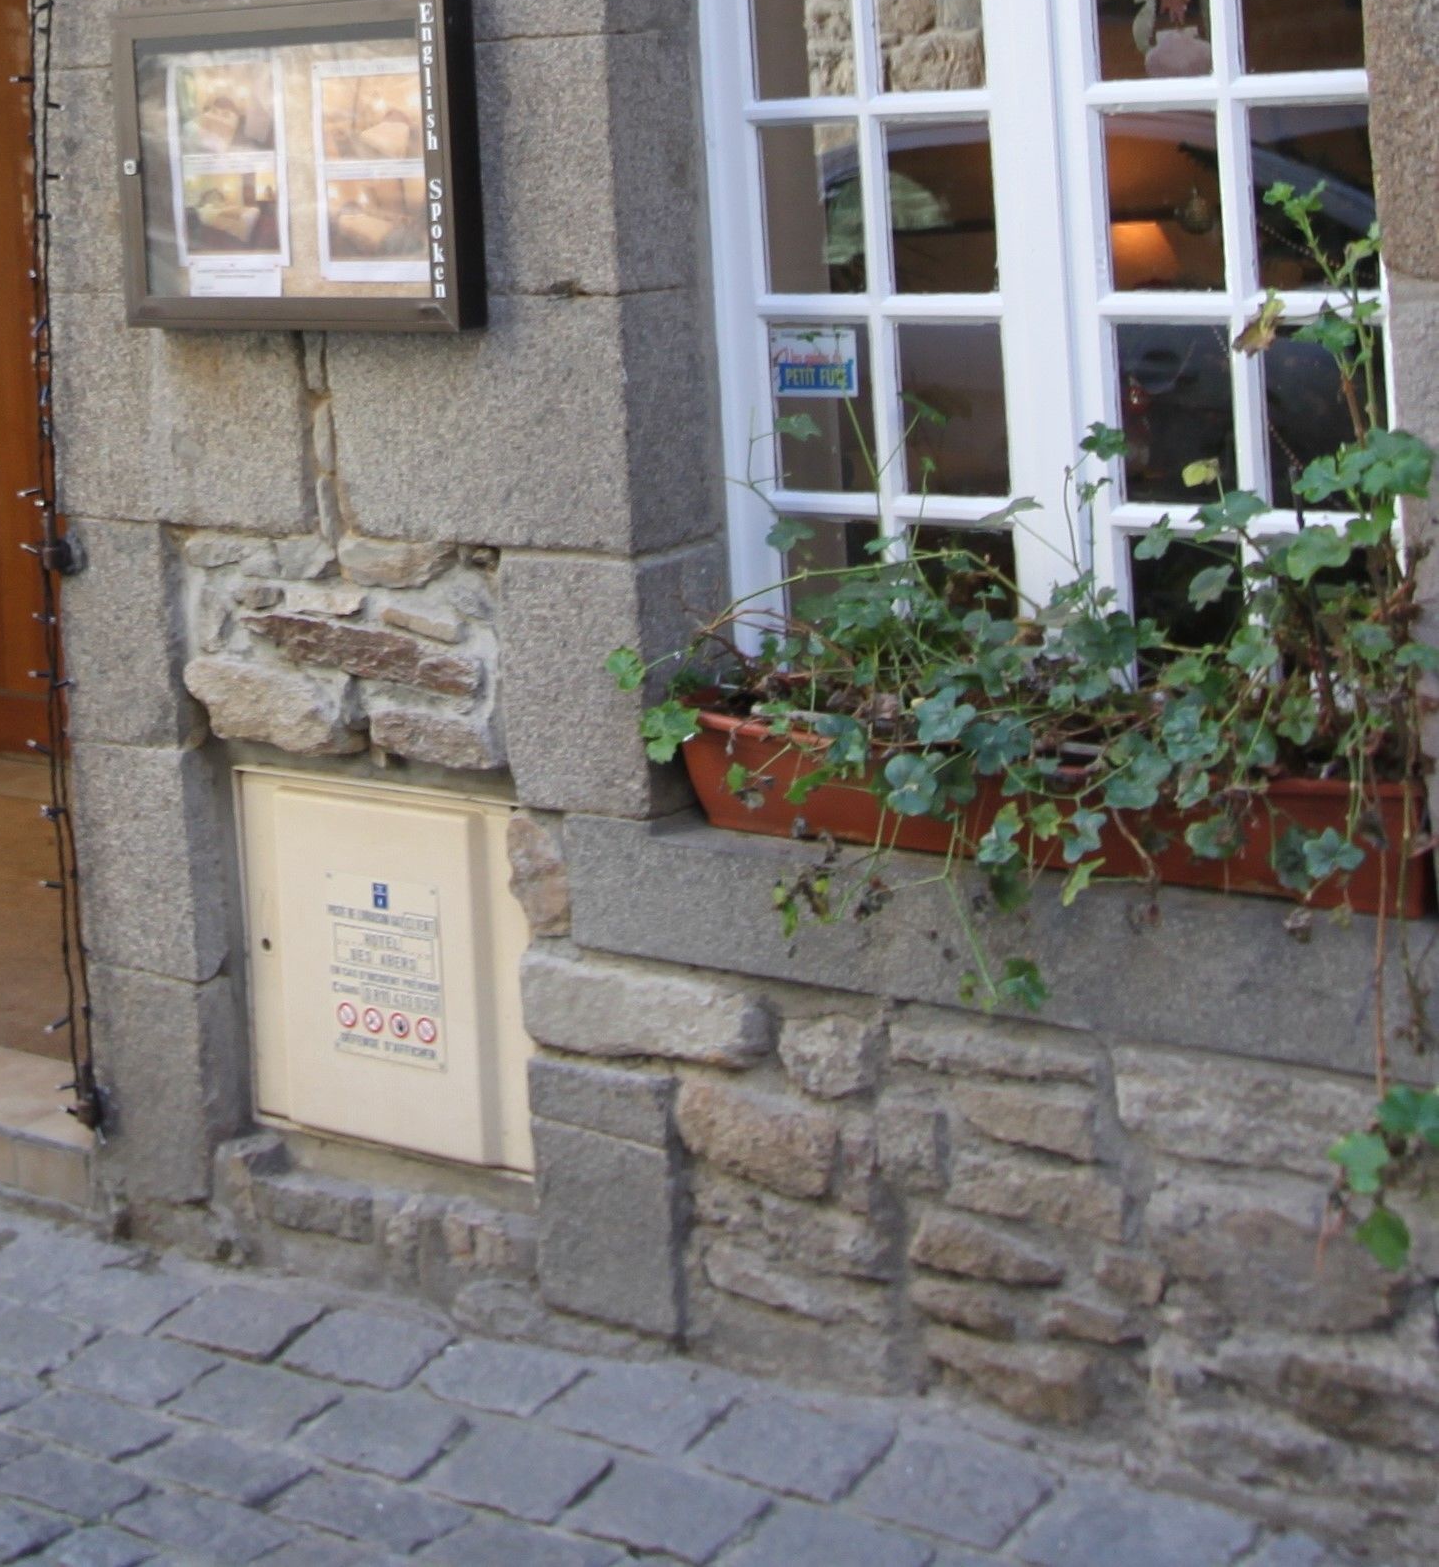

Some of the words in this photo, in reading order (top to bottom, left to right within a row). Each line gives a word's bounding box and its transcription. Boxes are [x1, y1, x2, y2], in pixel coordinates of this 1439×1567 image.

[418, 1, 438, 151] English
[429, 178, 446, 299] Spoken
[785, 367, 814, 386] PETIT
